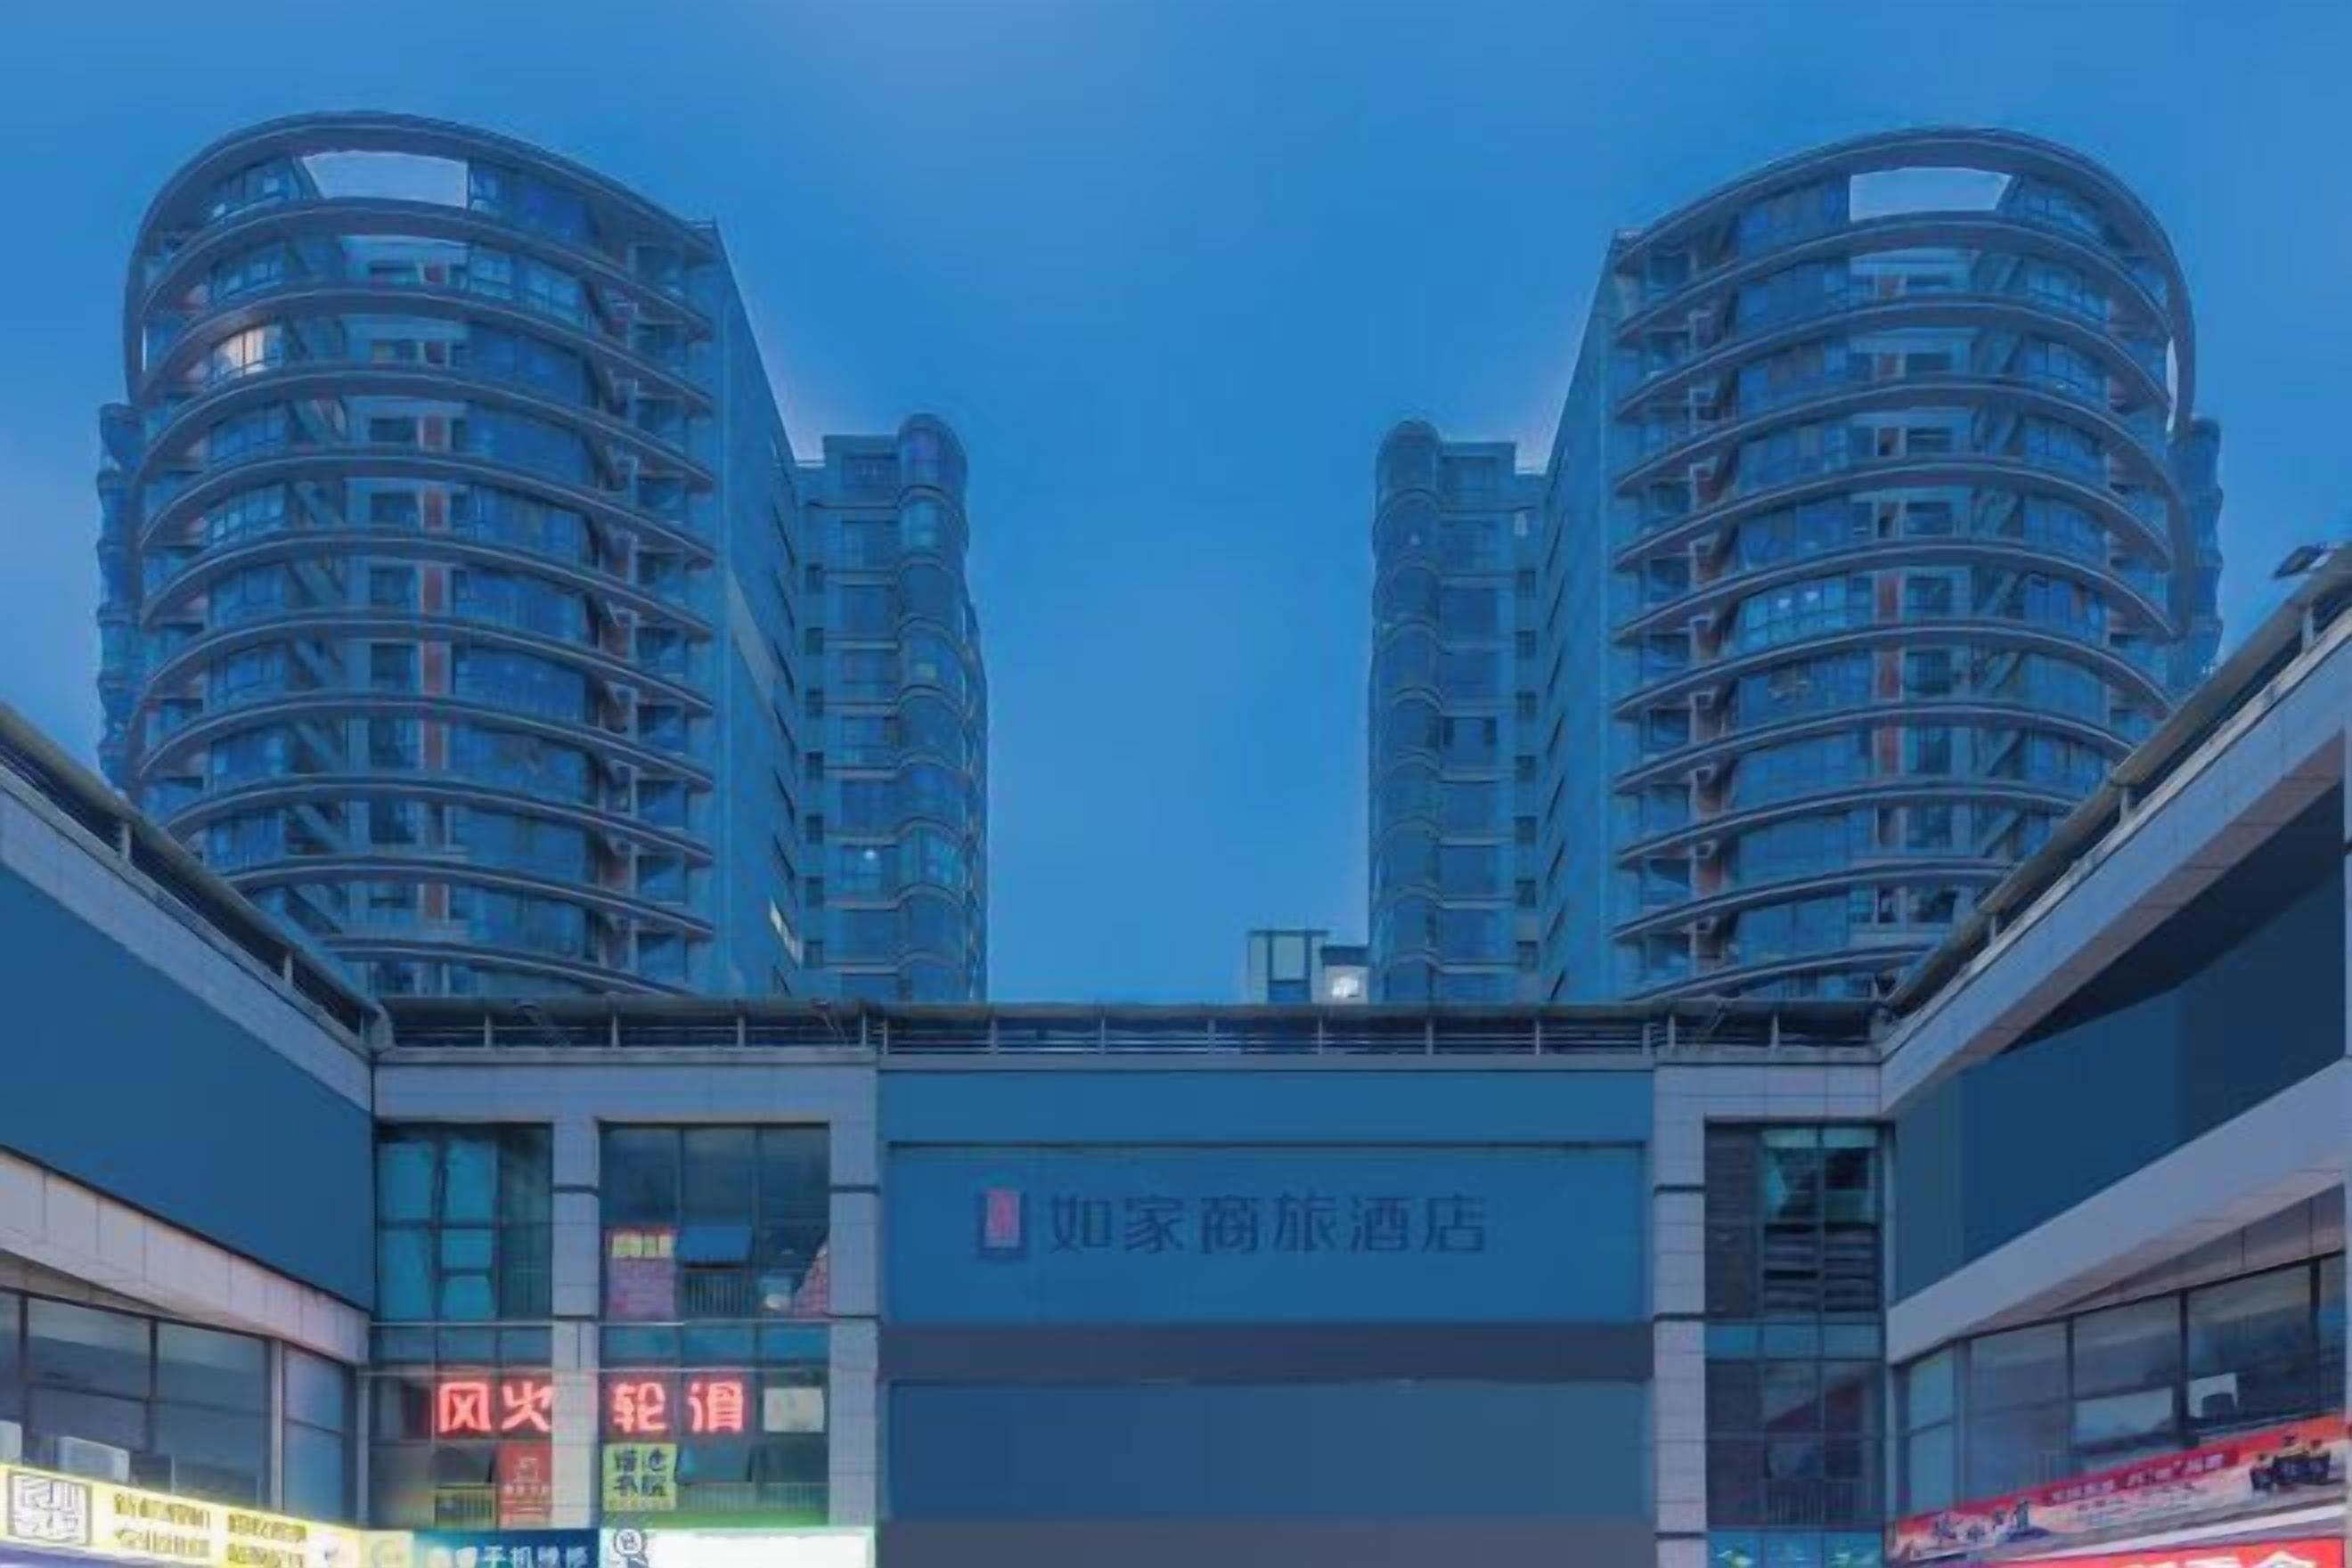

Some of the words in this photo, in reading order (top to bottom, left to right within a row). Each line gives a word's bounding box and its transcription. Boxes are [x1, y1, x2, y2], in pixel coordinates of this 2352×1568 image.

[1049, 1191, 1486, 1254] 如家商旅酒店
